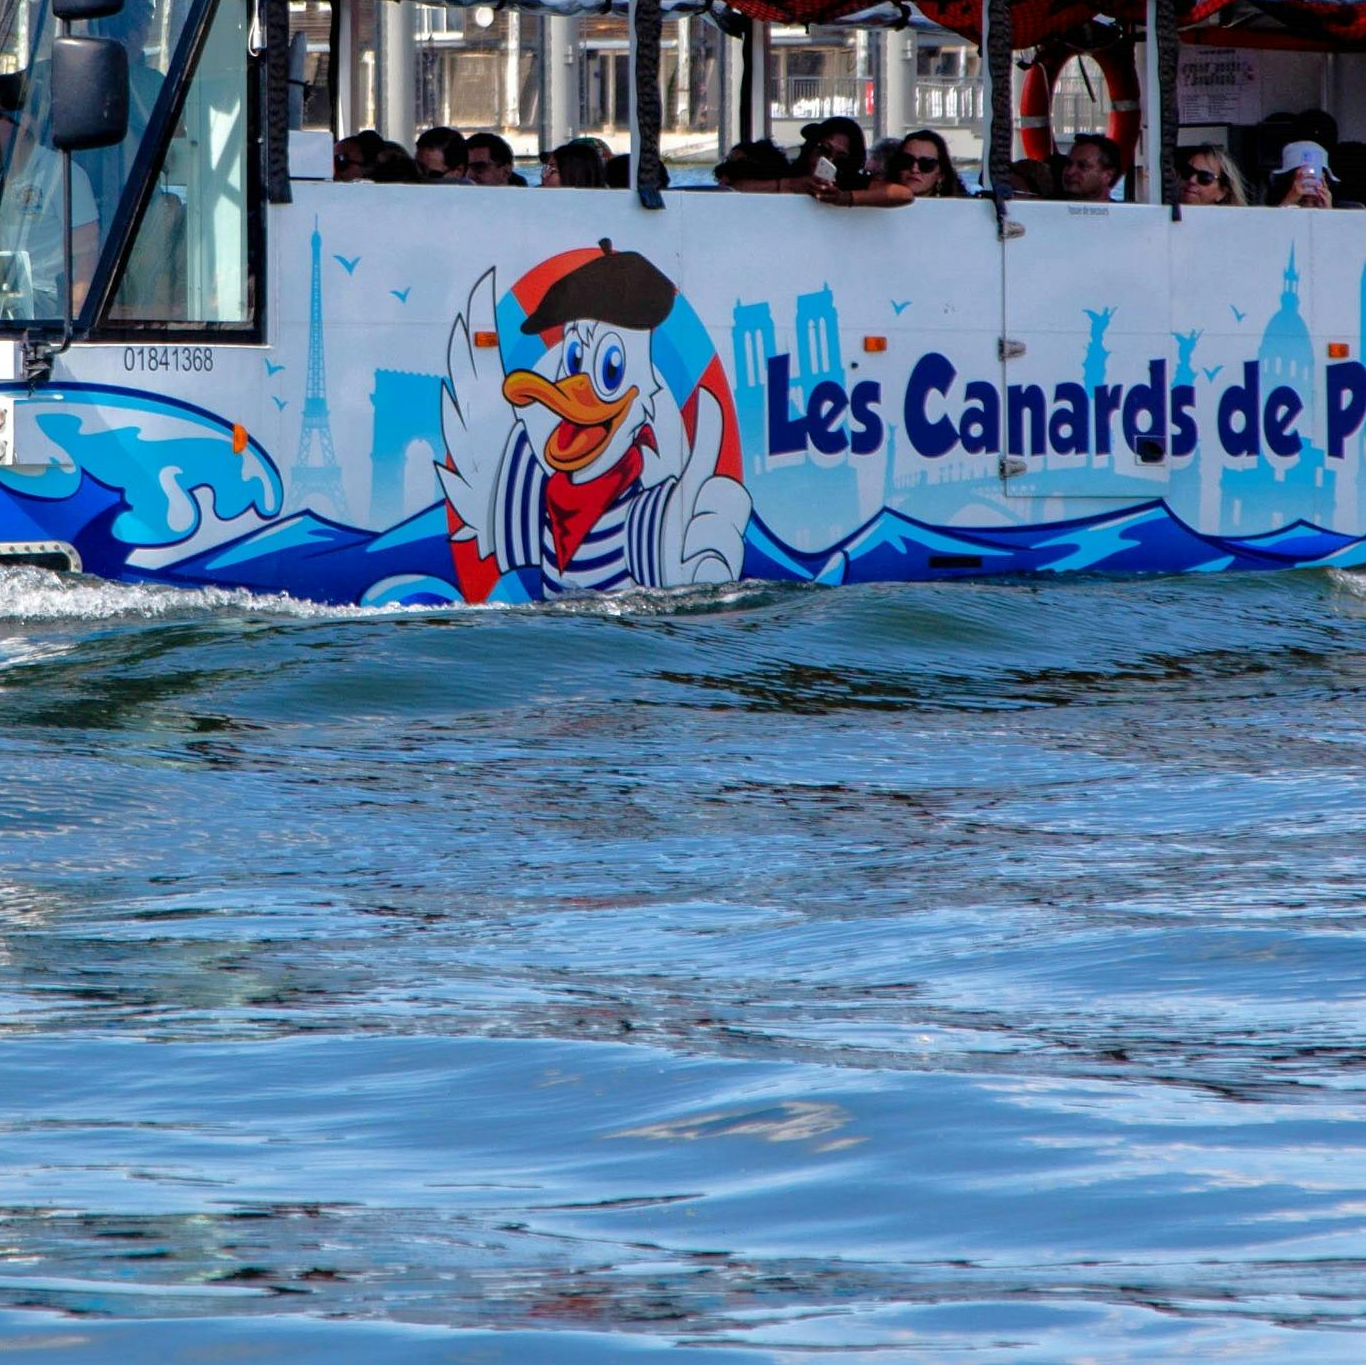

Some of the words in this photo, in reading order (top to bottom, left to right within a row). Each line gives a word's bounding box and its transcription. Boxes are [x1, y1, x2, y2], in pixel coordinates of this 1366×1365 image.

[124, 347, 214, 372] 01841368
[767, 353, 884, 457] Les
[904, 352, 1198, 459] Canards
[1217, 360, 1304, 457] de
